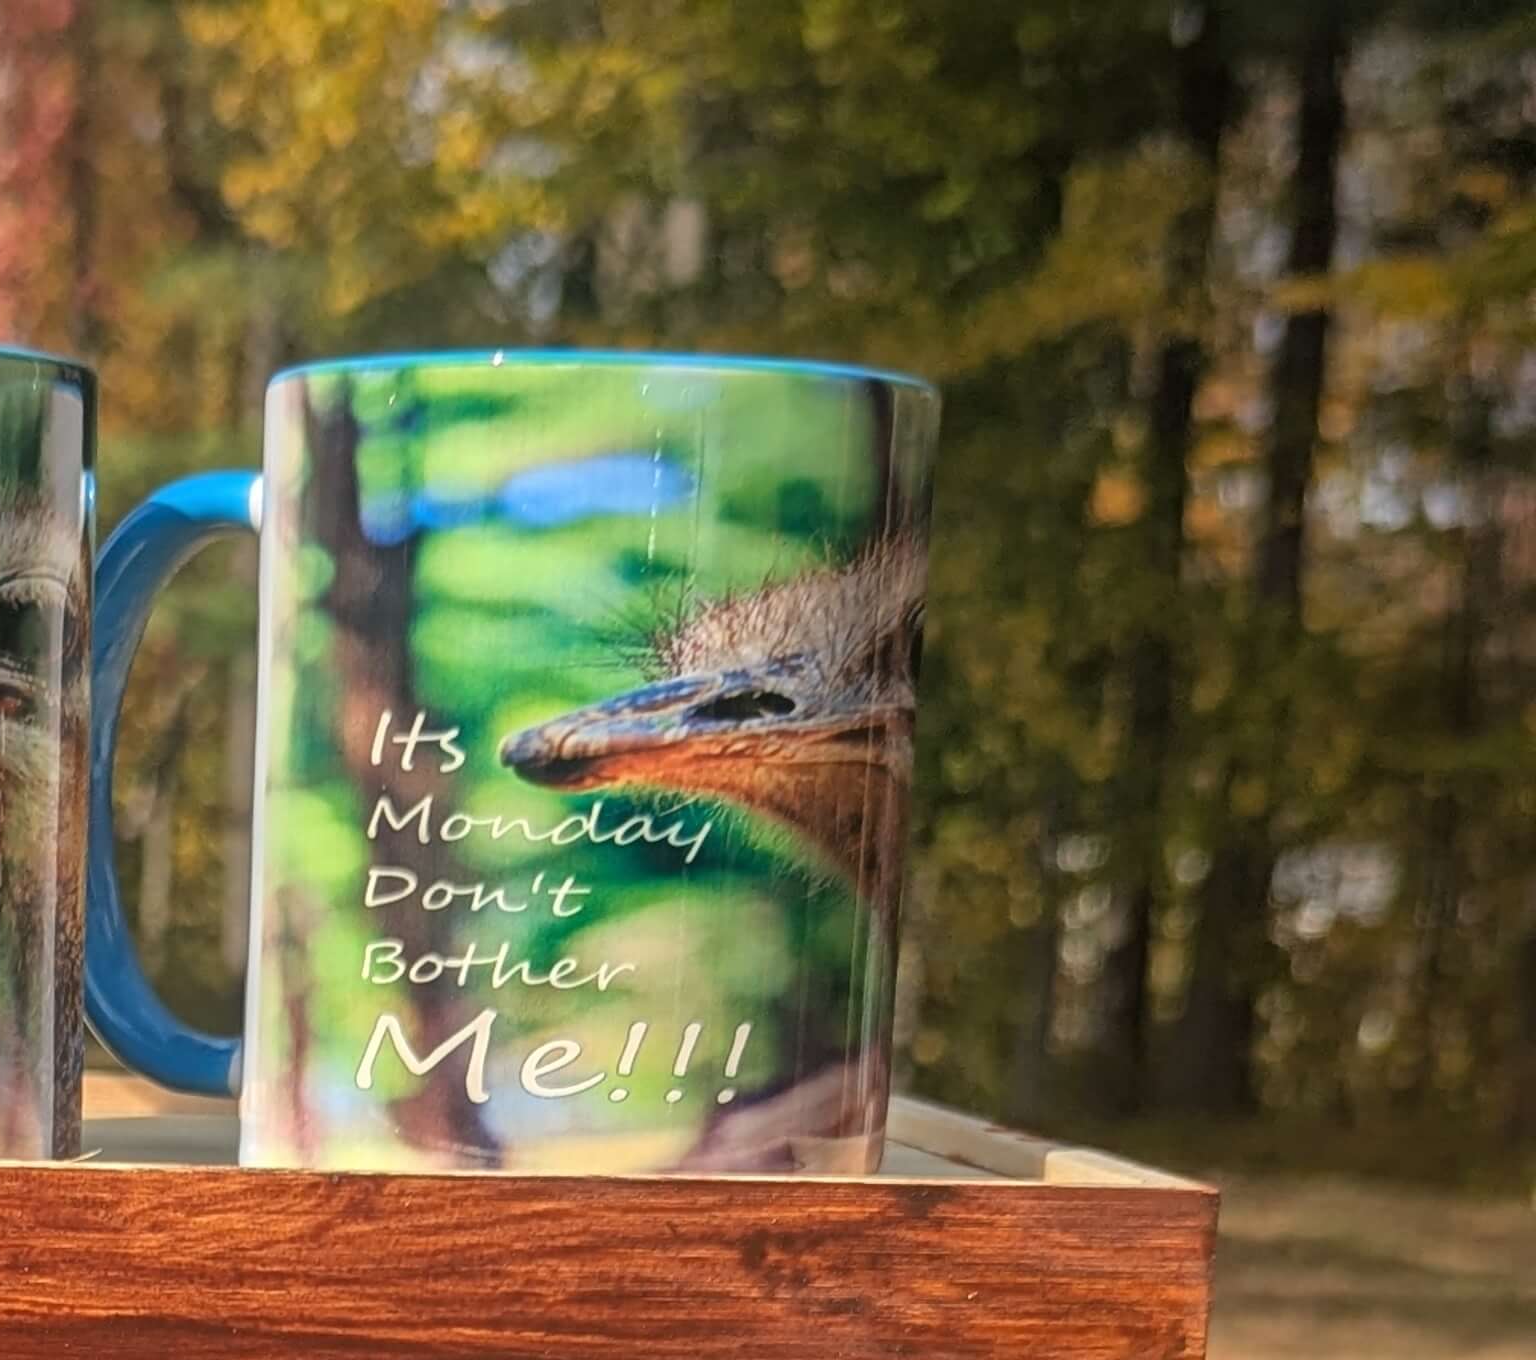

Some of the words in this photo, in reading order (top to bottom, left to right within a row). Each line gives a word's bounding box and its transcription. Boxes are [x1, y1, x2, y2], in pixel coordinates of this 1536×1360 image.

[370, 709, 465, 773] Its
[367, 794, 713, 864] Monday
[364, 868, 591, 917] Don't
[361, 938, 636, 991] Bother
[354, 1007, 752, 1105] Me!!!
